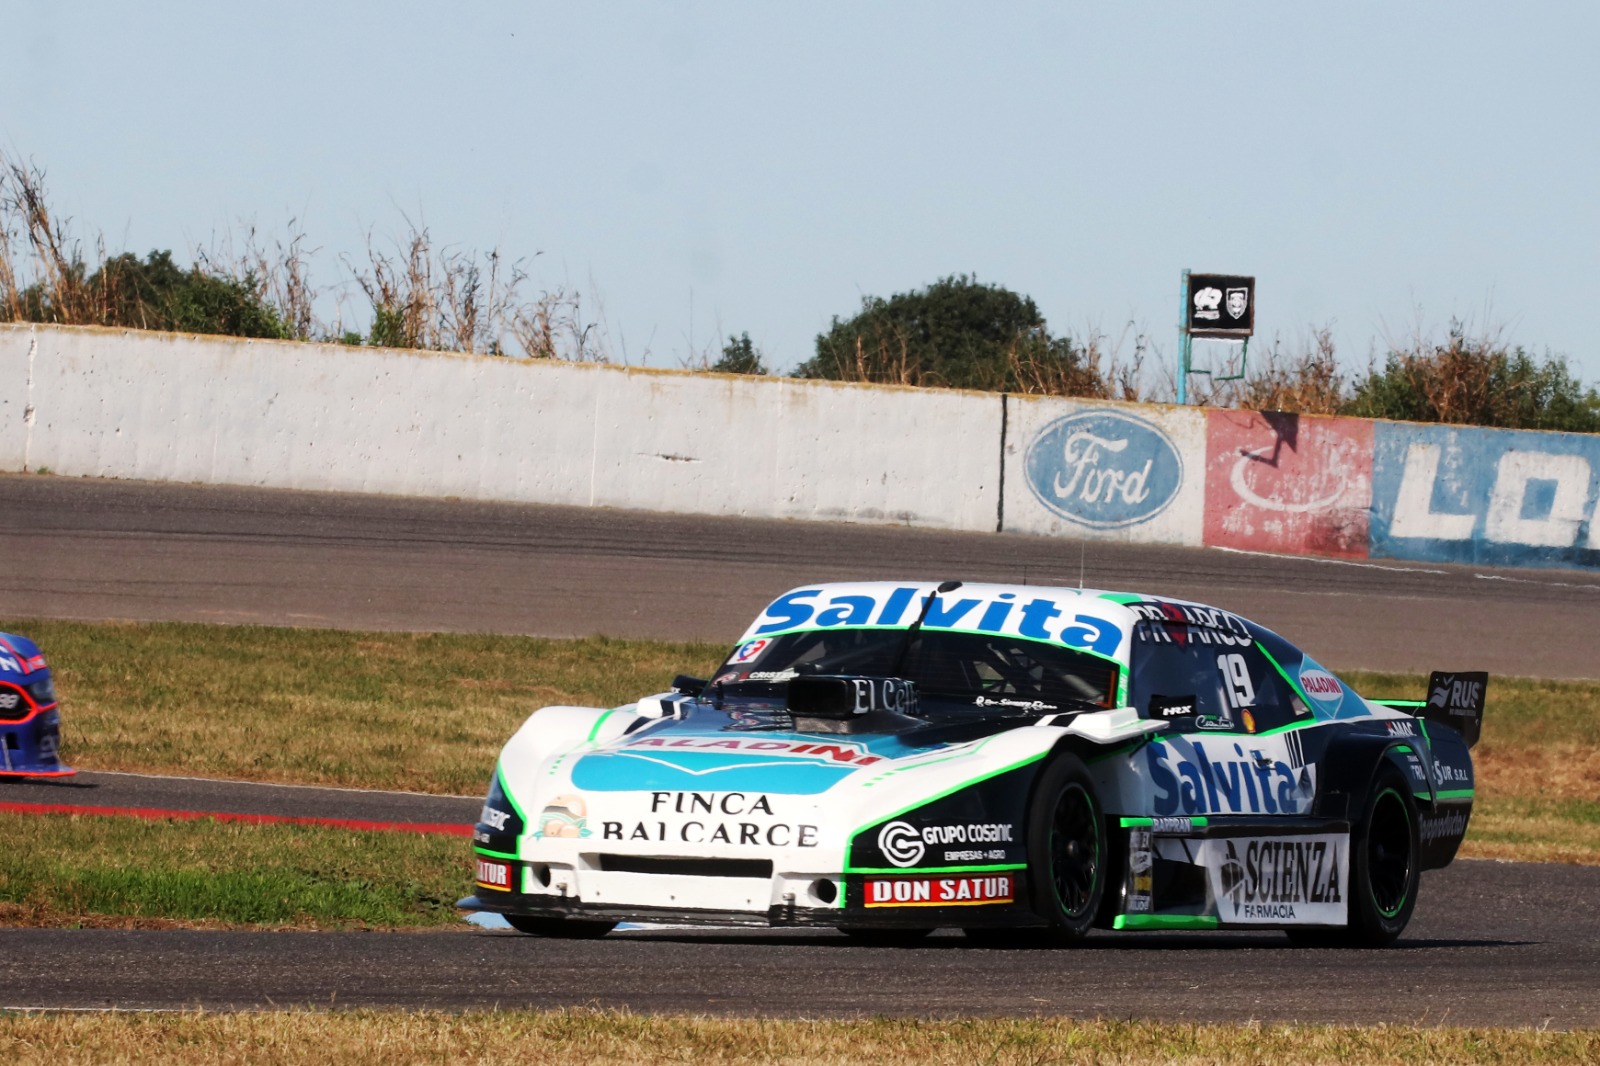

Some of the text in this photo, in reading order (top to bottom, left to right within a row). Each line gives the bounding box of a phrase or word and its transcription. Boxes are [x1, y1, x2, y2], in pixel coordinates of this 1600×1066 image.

[1054, 431, 1153, 504] Ford
[1389, 443, 1600, 551] LO
[755, 587, 1123, 657] Salvita
[1217, 653, 1256, 708] 19
[1300, 676, 1343, 694] PALADINI
[1450, 680, 1481, 708] RUS
[1162, 705, 1192, 716] HRX
[1147, 741, 1298, 815] Salvita
[651, 792, 775, 816] FINCA
[944, 850, 983, 861] EMPRESAS
[988, 849, 1006, 860] AGRO
[1244, 840, 1342, 904] SCIENZA
[873, 877, 1009, 902] DON SATUR
[1244, 904, 1297, 919] FARMACIA
